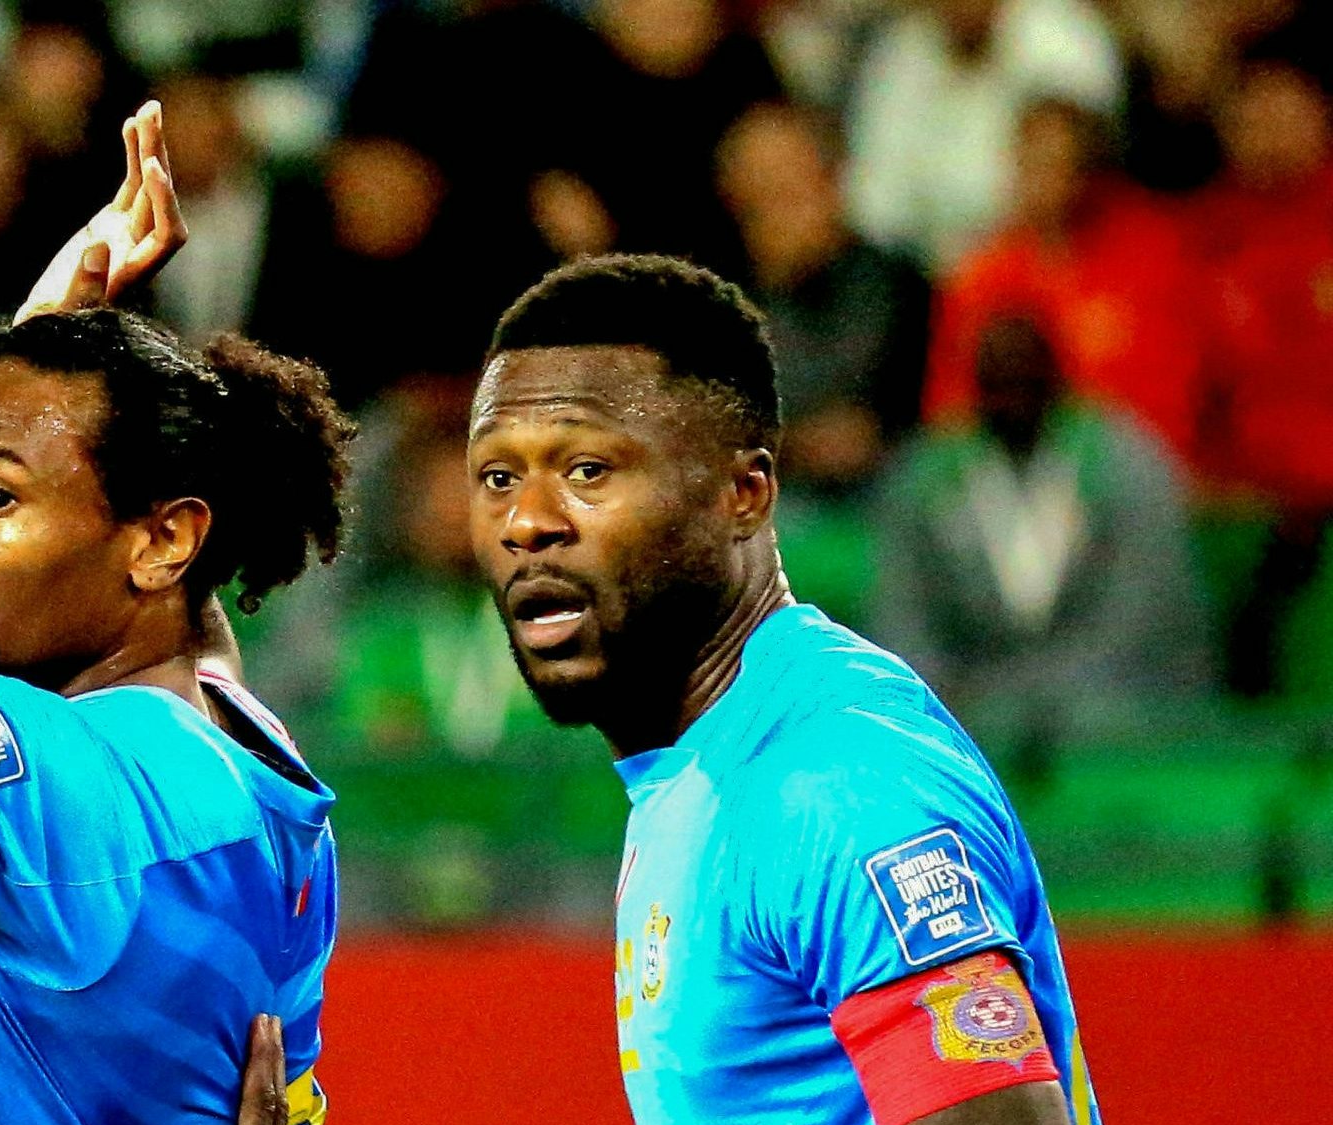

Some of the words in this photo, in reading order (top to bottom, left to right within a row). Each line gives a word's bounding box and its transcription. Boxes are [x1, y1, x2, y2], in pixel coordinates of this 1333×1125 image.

[889, 848, 951, 883] FOOTBALL
[896, 863, 960, 904] UNITES
[904, 901, 931, 925] the
[928, 884, 968, 915] World
[935, 917, 958, 932] FIFA
